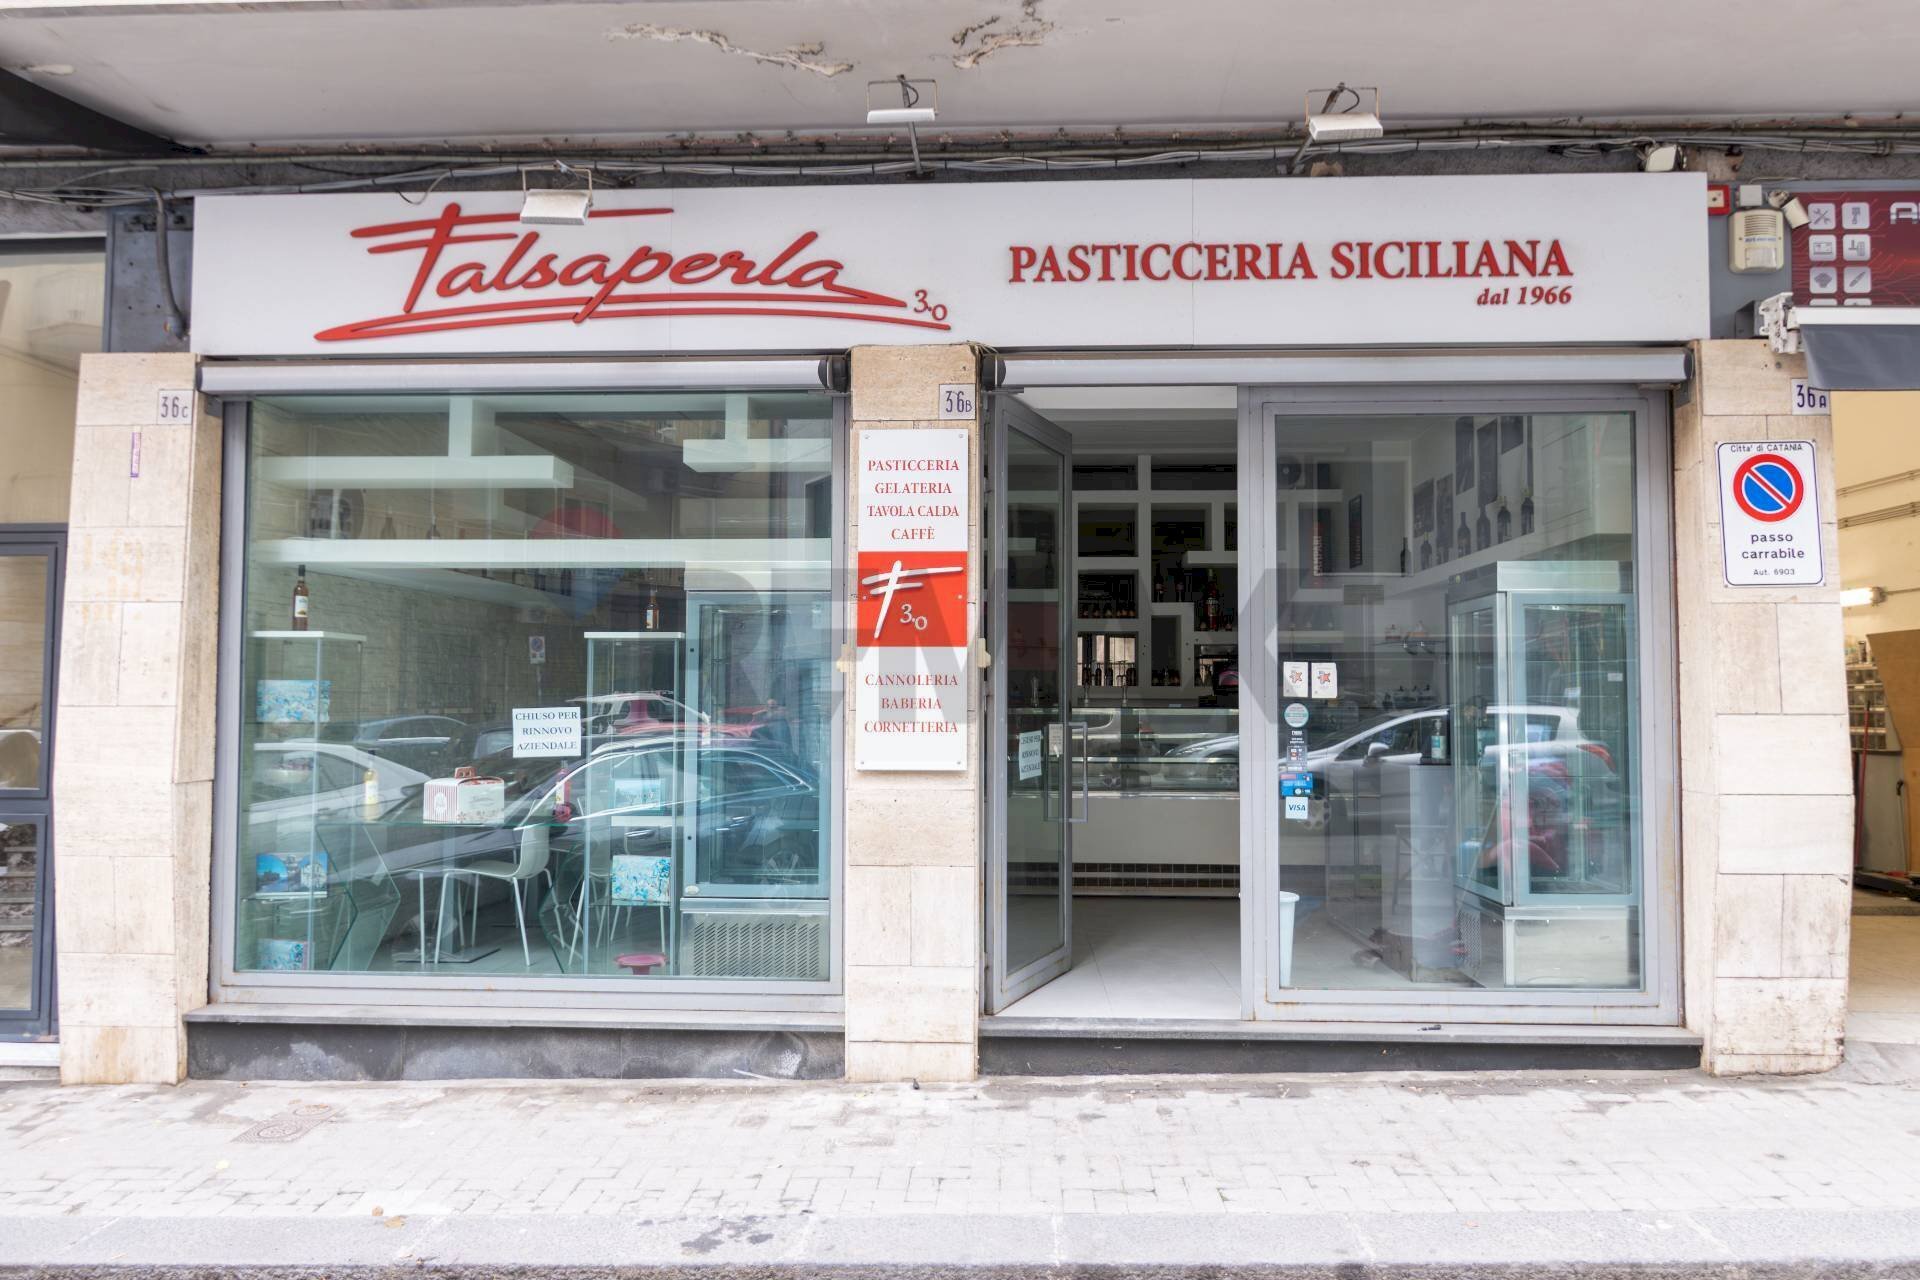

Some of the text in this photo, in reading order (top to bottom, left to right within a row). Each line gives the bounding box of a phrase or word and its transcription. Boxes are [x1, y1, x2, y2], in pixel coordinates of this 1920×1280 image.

[1890, 202, 1920, 225] A
[340, 202, 906, 324] Falsaperla
[1008, 239, 1574, 285] PASTICCERIA SICILIANA
[1476, 285, 1574, 306] dal 1966
[914, 288, 949, 321] 3.0
[1756, 444, 1764, 453] di
[1766, 443, 1803, 453] CATANIA
[867, 459, 960, 472] PASTICCERIA
[874, 482, 952, 494] GELATERIA
[867, 505, 960, 517] TAVOLA CALDA
[890, 526, 935, 540] CAFFÈ
[1750, 533, 1794, 545] passo
[1741, 548, 1805, 560] carrabile
[1753, 568, 1796, 577] Aut. 6903
[900, 603, 929, 631] 3.0
[864, 674, 959, 687] CANNOLERIA
[880, 697, 943, 710] BABERIA
[515, 711, 578, 721] CHIUSO PER
[522, 726, 572, 736] RINNOVO
[863, 720, 959, 734] CORNETTERIA
[517, 741, 577, 751] AZIENDALE
[1288, 804, 1306, 812] VISA
